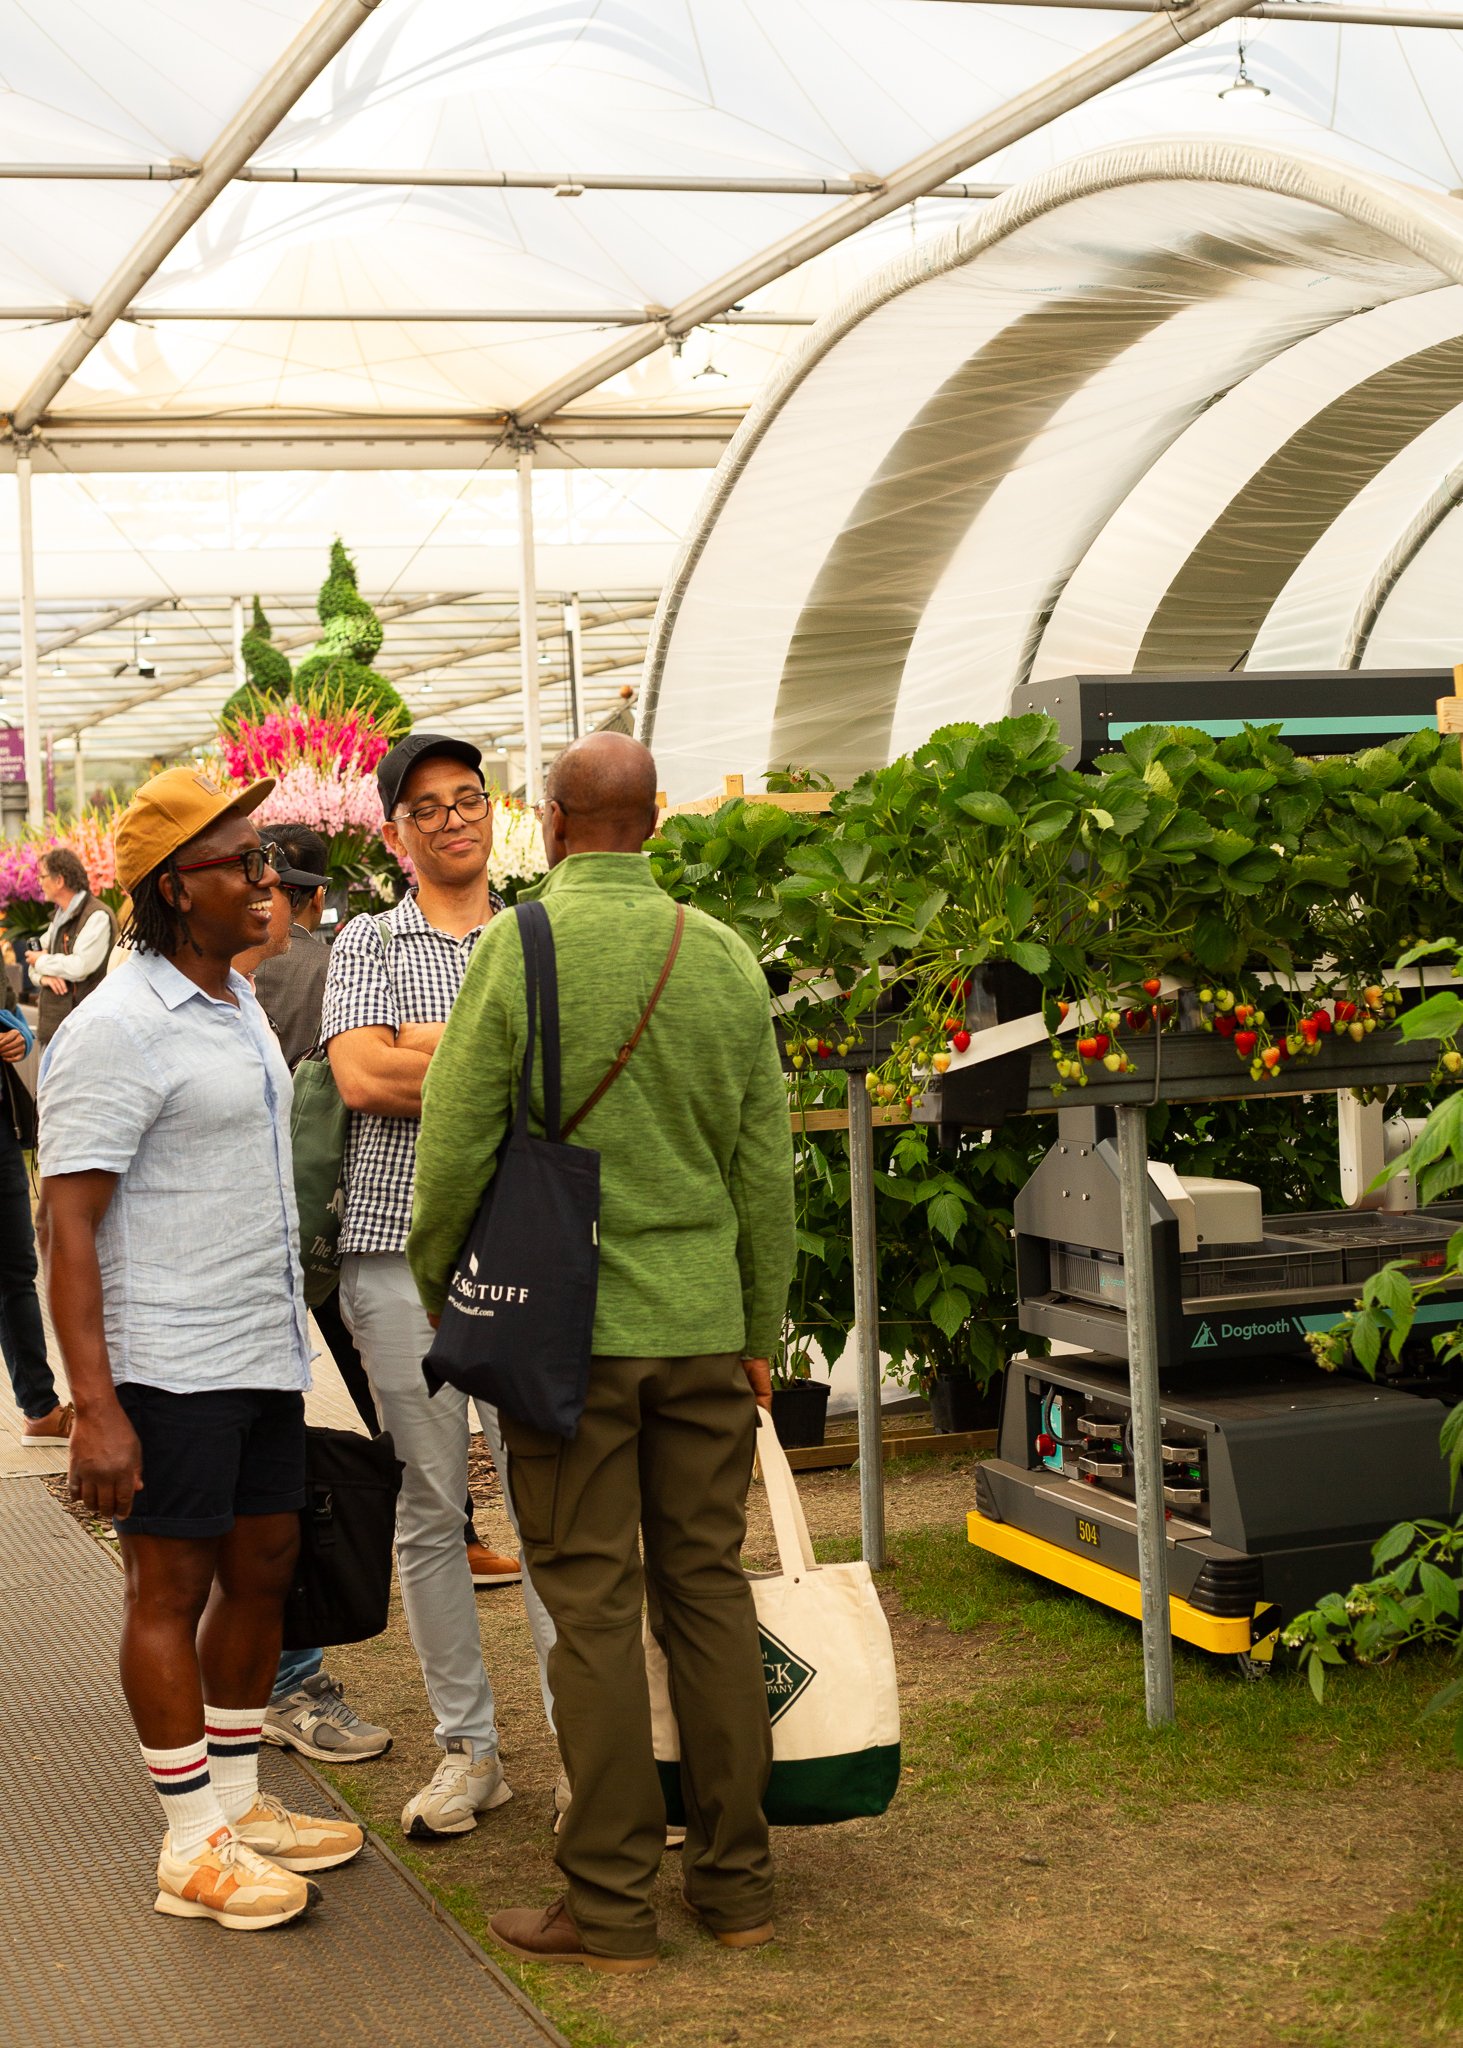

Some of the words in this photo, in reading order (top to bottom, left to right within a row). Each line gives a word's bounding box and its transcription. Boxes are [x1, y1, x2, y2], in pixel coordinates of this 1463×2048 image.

[310, 1235, 332, 1258] The
[1221, 1318, 1290, 1340] Dogtooth
[1079, 1520, 1097, 1545] 504
[292, 1711, 319, 1731] N
